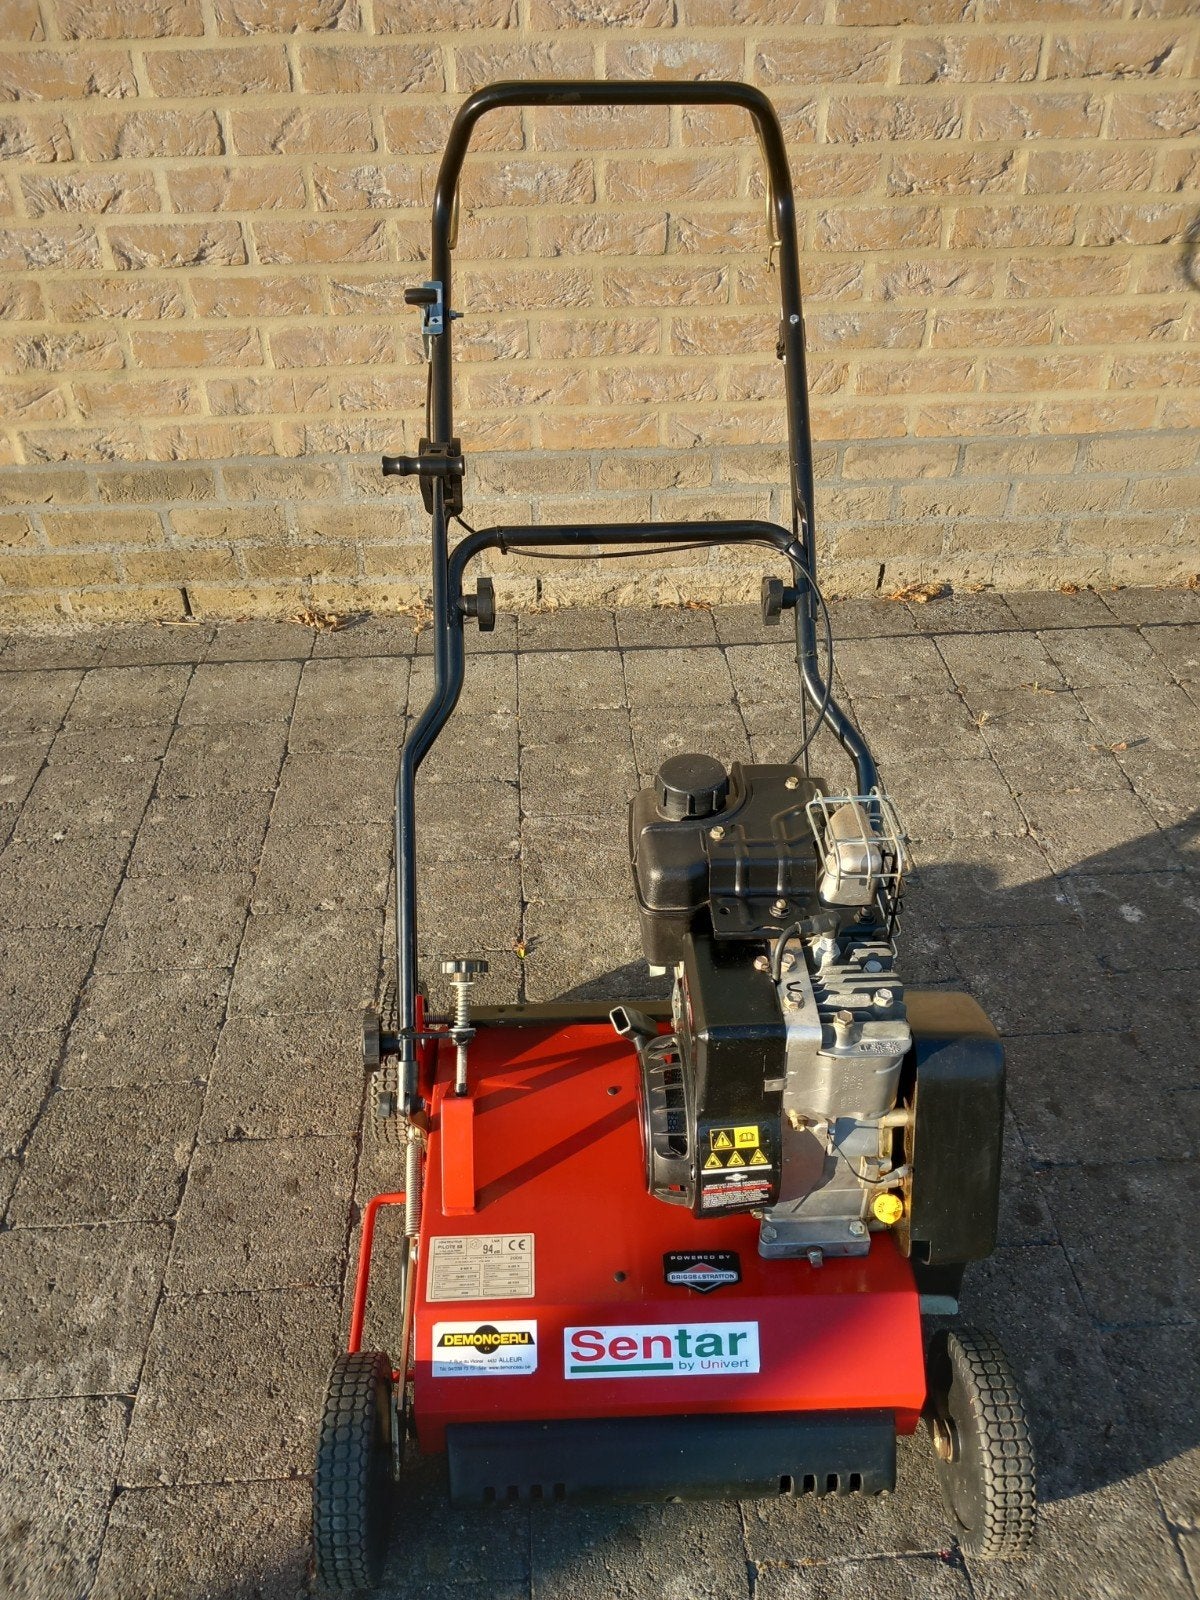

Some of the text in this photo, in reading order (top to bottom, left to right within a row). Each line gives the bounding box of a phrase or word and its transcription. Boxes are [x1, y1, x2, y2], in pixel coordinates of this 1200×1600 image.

[483, 1244, 493, 1254] 94
[444, 1333, 528, 1346] DEMONCEAU
[570, 1329, 747, 1362] Sentar
[679, 1359, 750, 1371] by Univert
